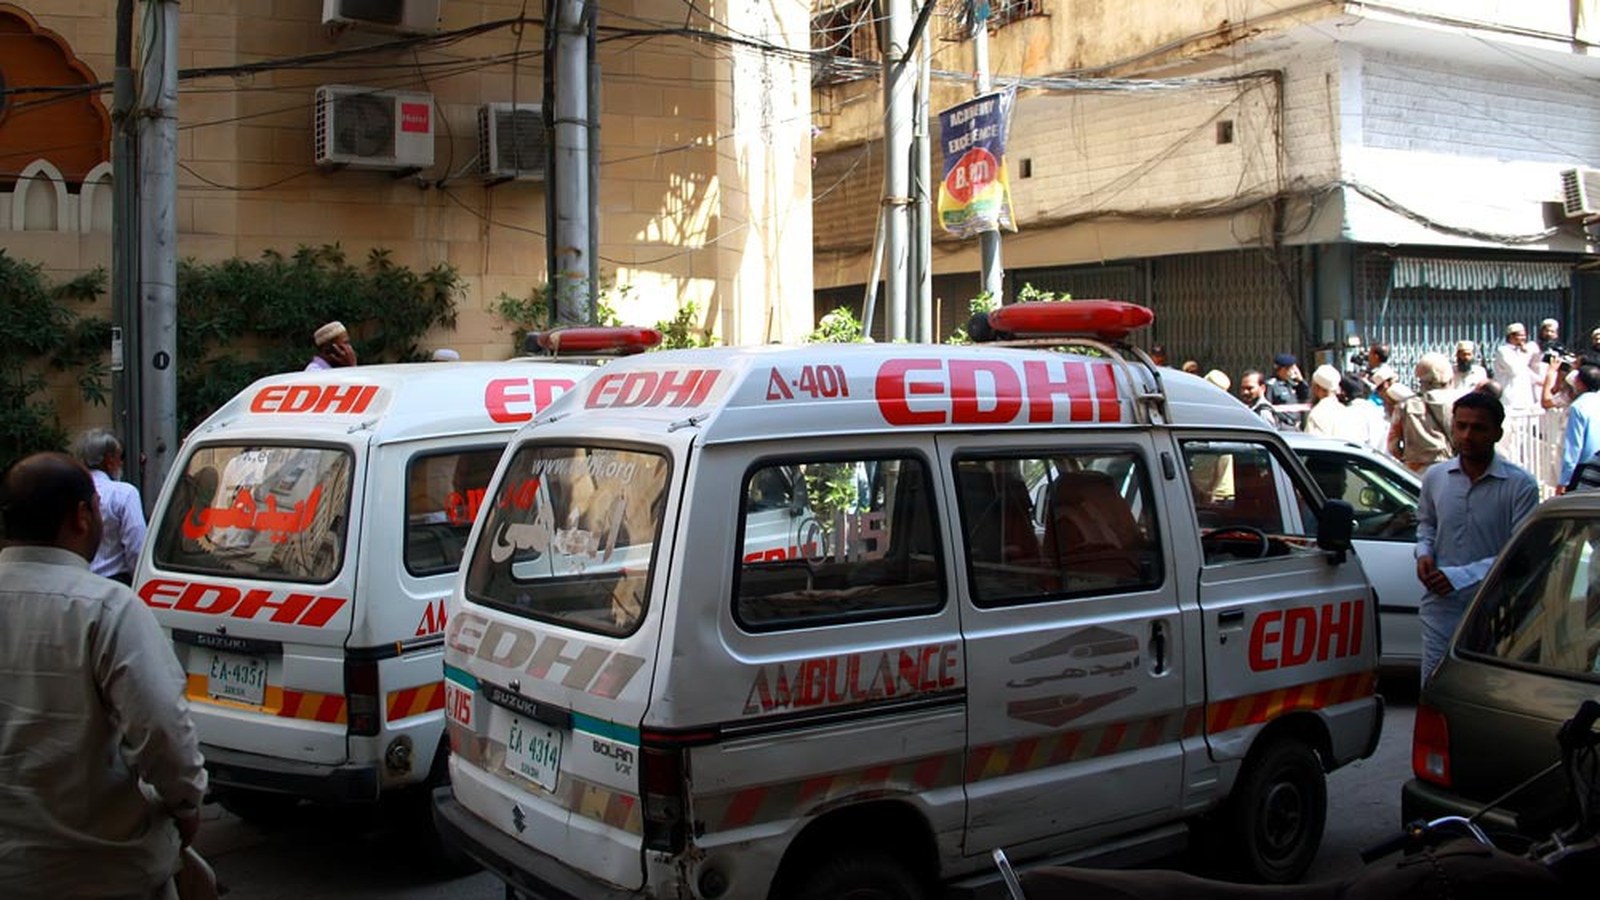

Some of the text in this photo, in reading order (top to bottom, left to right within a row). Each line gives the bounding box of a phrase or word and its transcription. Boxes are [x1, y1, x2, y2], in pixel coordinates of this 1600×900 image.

[250, 385, 380, 414] EDHI
[484, 378, 577, 423] ED
[584, 369, 721, 409] EDHI
[766, 365, 850, 401] A-401
[875, 358, 1121, 426] EDHI
[137, 579, 348, 628] EDHI
[448, 612, 646, 699] EDHI
[1250, 600, 1364, 672] EDHI
[745, 644, 957, 714] AMBULANCE
[492, 689, 538, 716] SUZUKI
[508, 726, 559, 772] EA 4314
[592, 740, 634, 764] BOLAN
